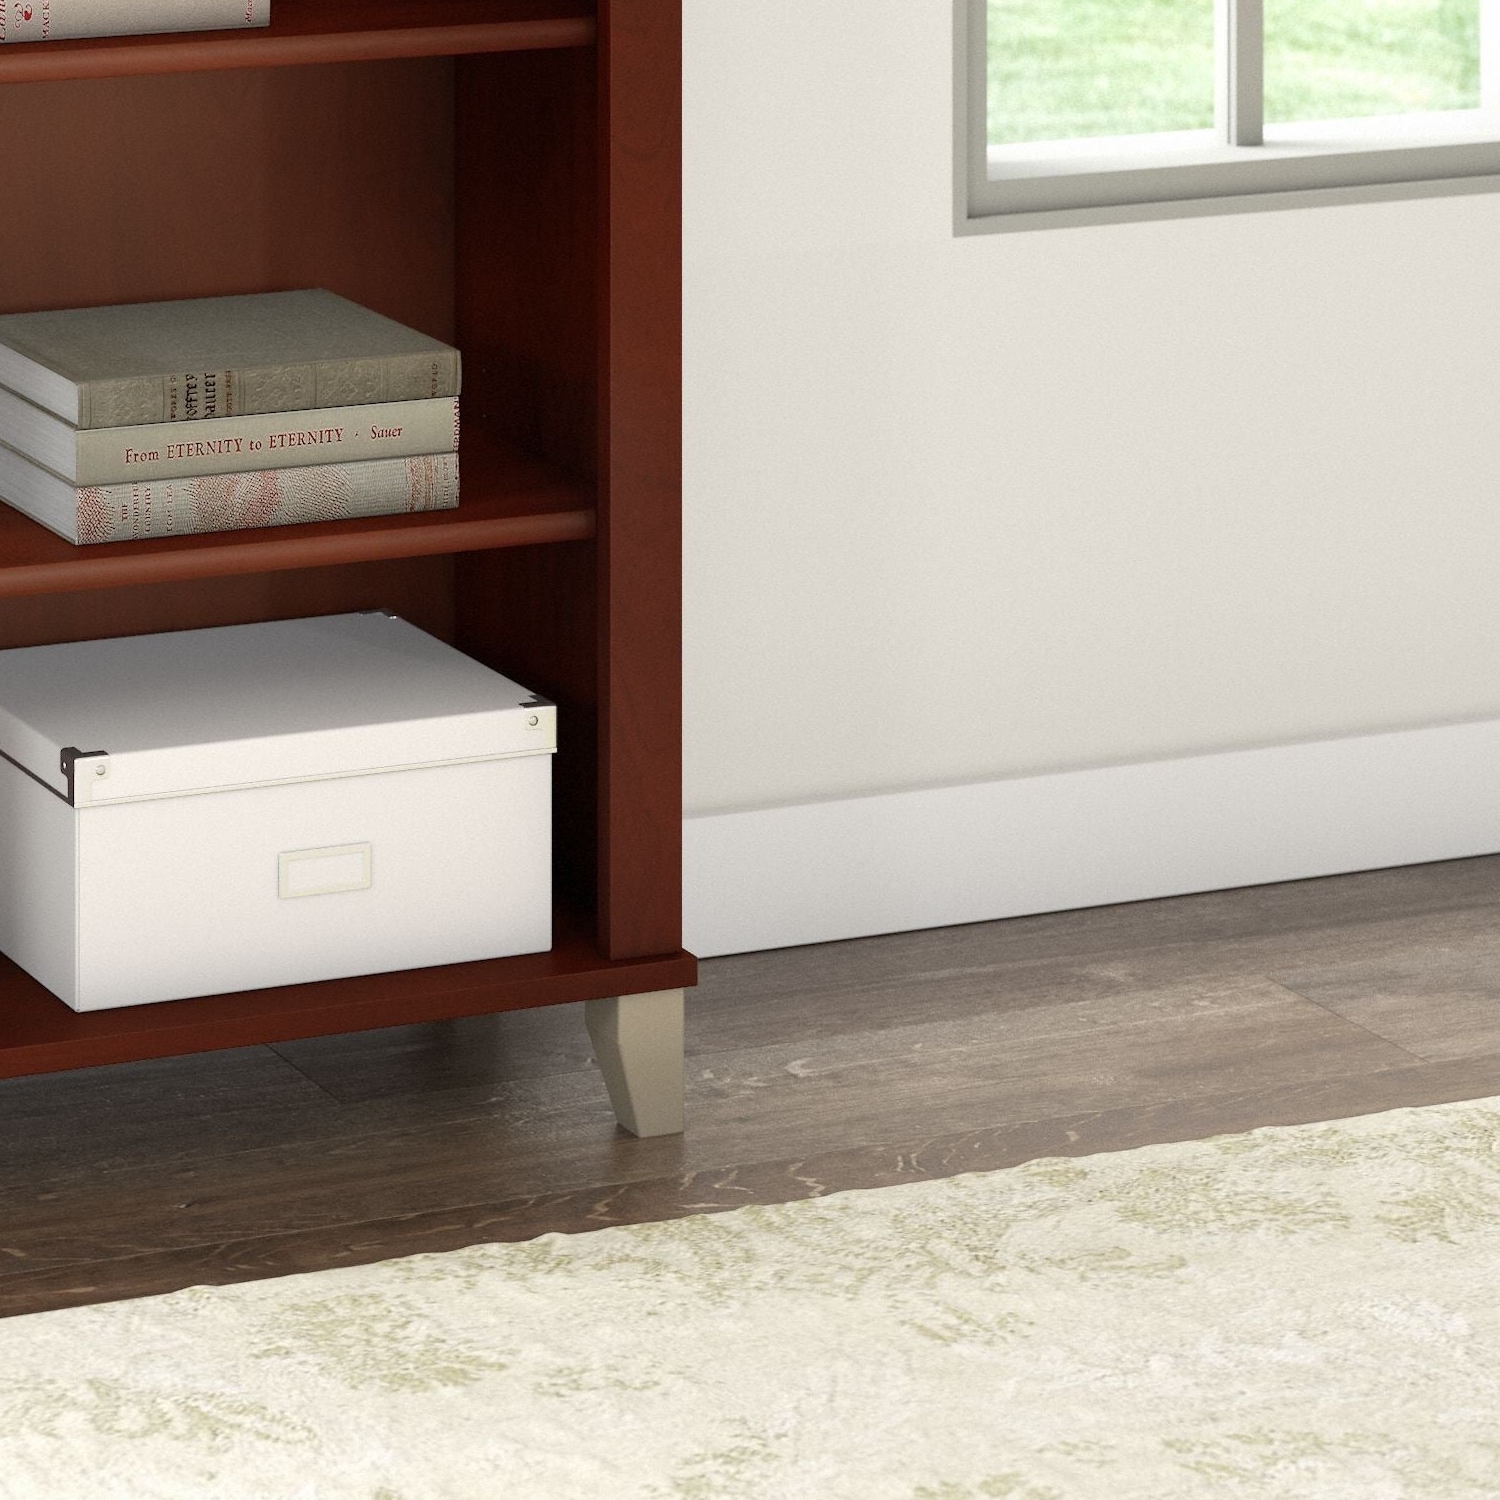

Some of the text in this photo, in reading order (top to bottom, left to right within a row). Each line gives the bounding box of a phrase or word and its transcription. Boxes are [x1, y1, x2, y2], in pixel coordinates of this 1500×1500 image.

[125, 425, 403, 463] From ETERNITY to ETERNITY Sauer
